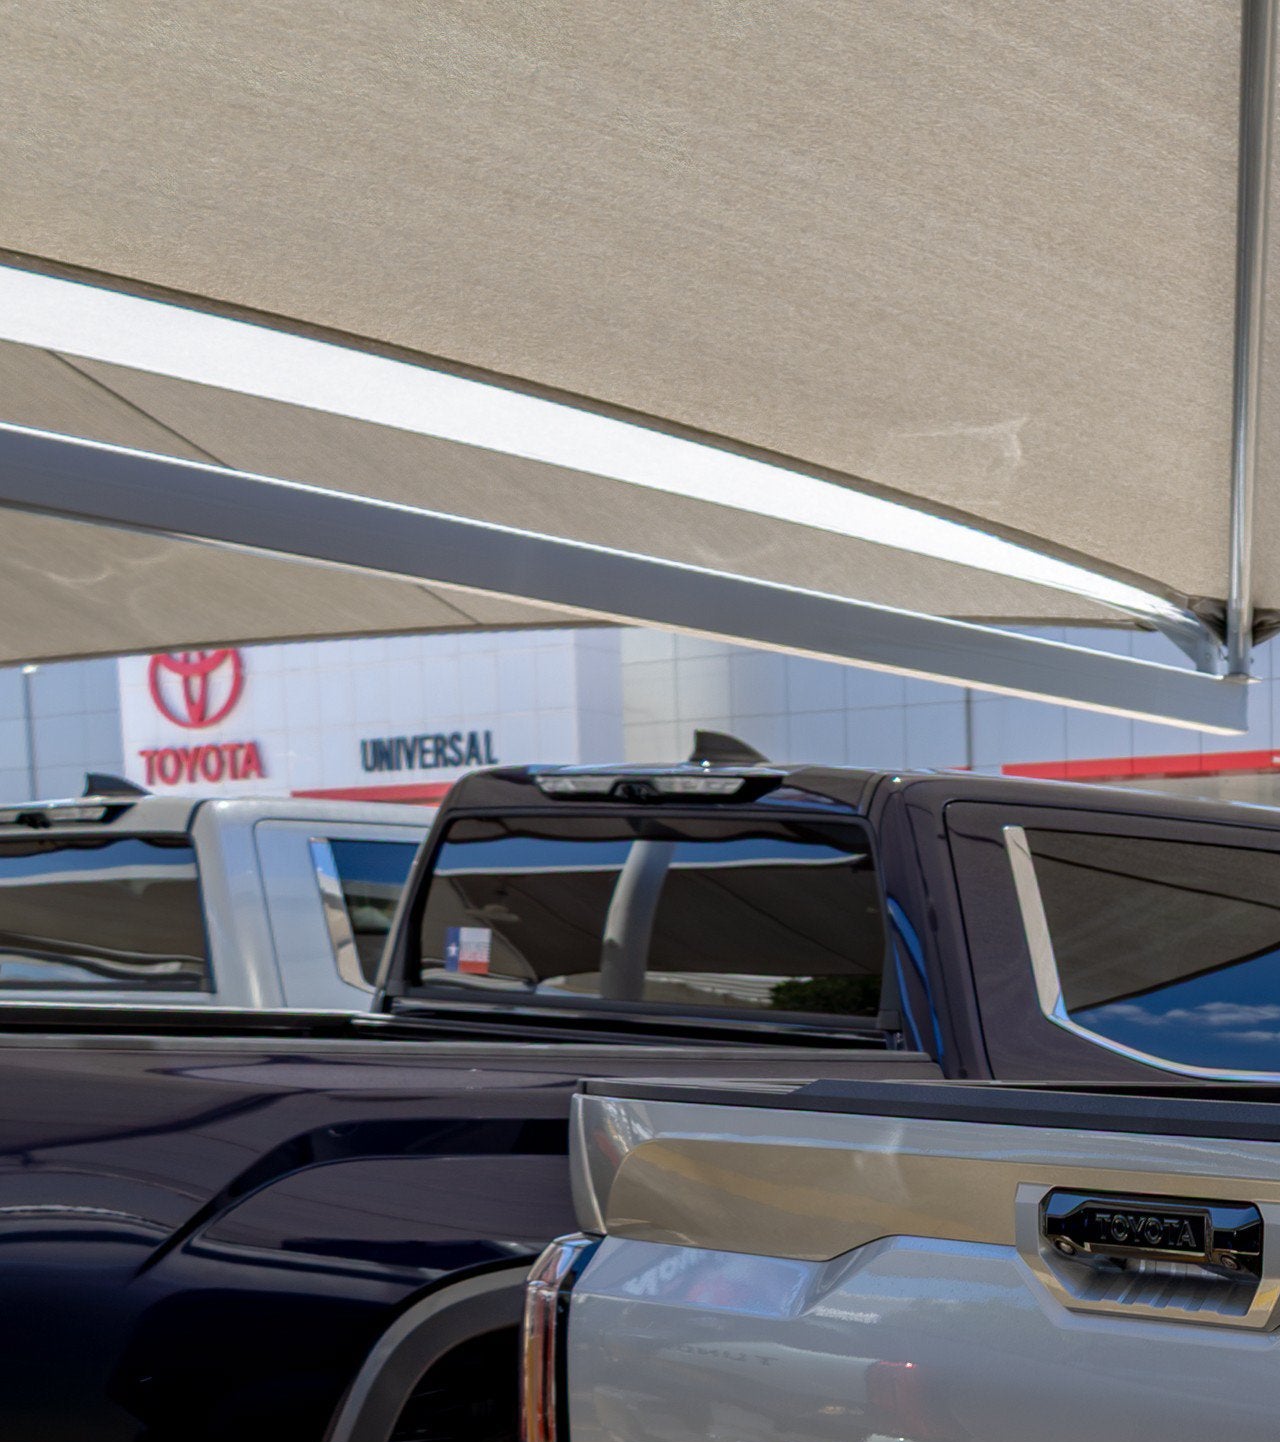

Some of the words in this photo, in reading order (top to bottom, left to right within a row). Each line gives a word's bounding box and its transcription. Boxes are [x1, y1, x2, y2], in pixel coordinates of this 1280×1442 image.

[139, 741, 267, 786] TOYOTA
[361, 730, 499, 772] UNIVERSAL
[1095, 1213, 1197, 1248] TOYOTA
